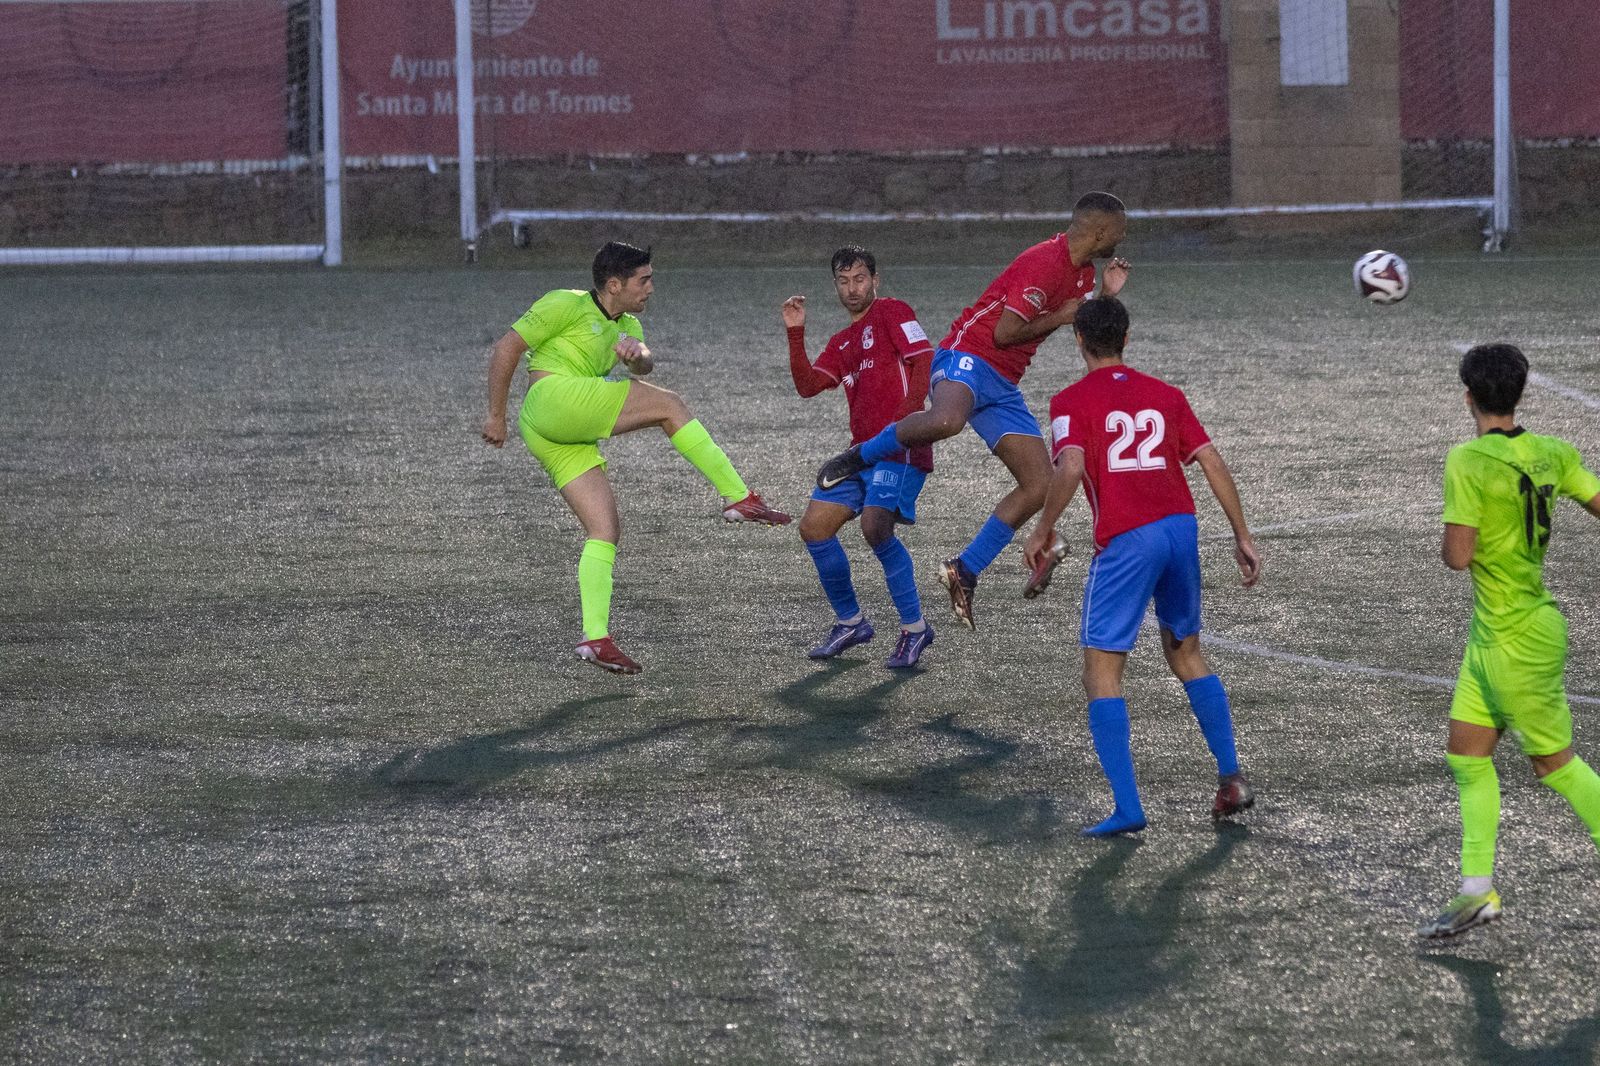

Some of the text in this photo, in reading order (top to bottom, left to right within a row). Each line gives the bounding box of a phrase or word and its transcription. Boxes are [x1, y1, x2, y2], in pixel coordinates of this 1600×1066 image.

[937, 0, 1209, 40] Limcasa
[570, 52, 600, 77] de
[1069, 42, 1211, 61] PROFESIONAL
[357, 89, 634, 116] Santa Mrta de Tormes
[958, 356, 974, 371] 6
[1105, 409, 1167, 472] 22
